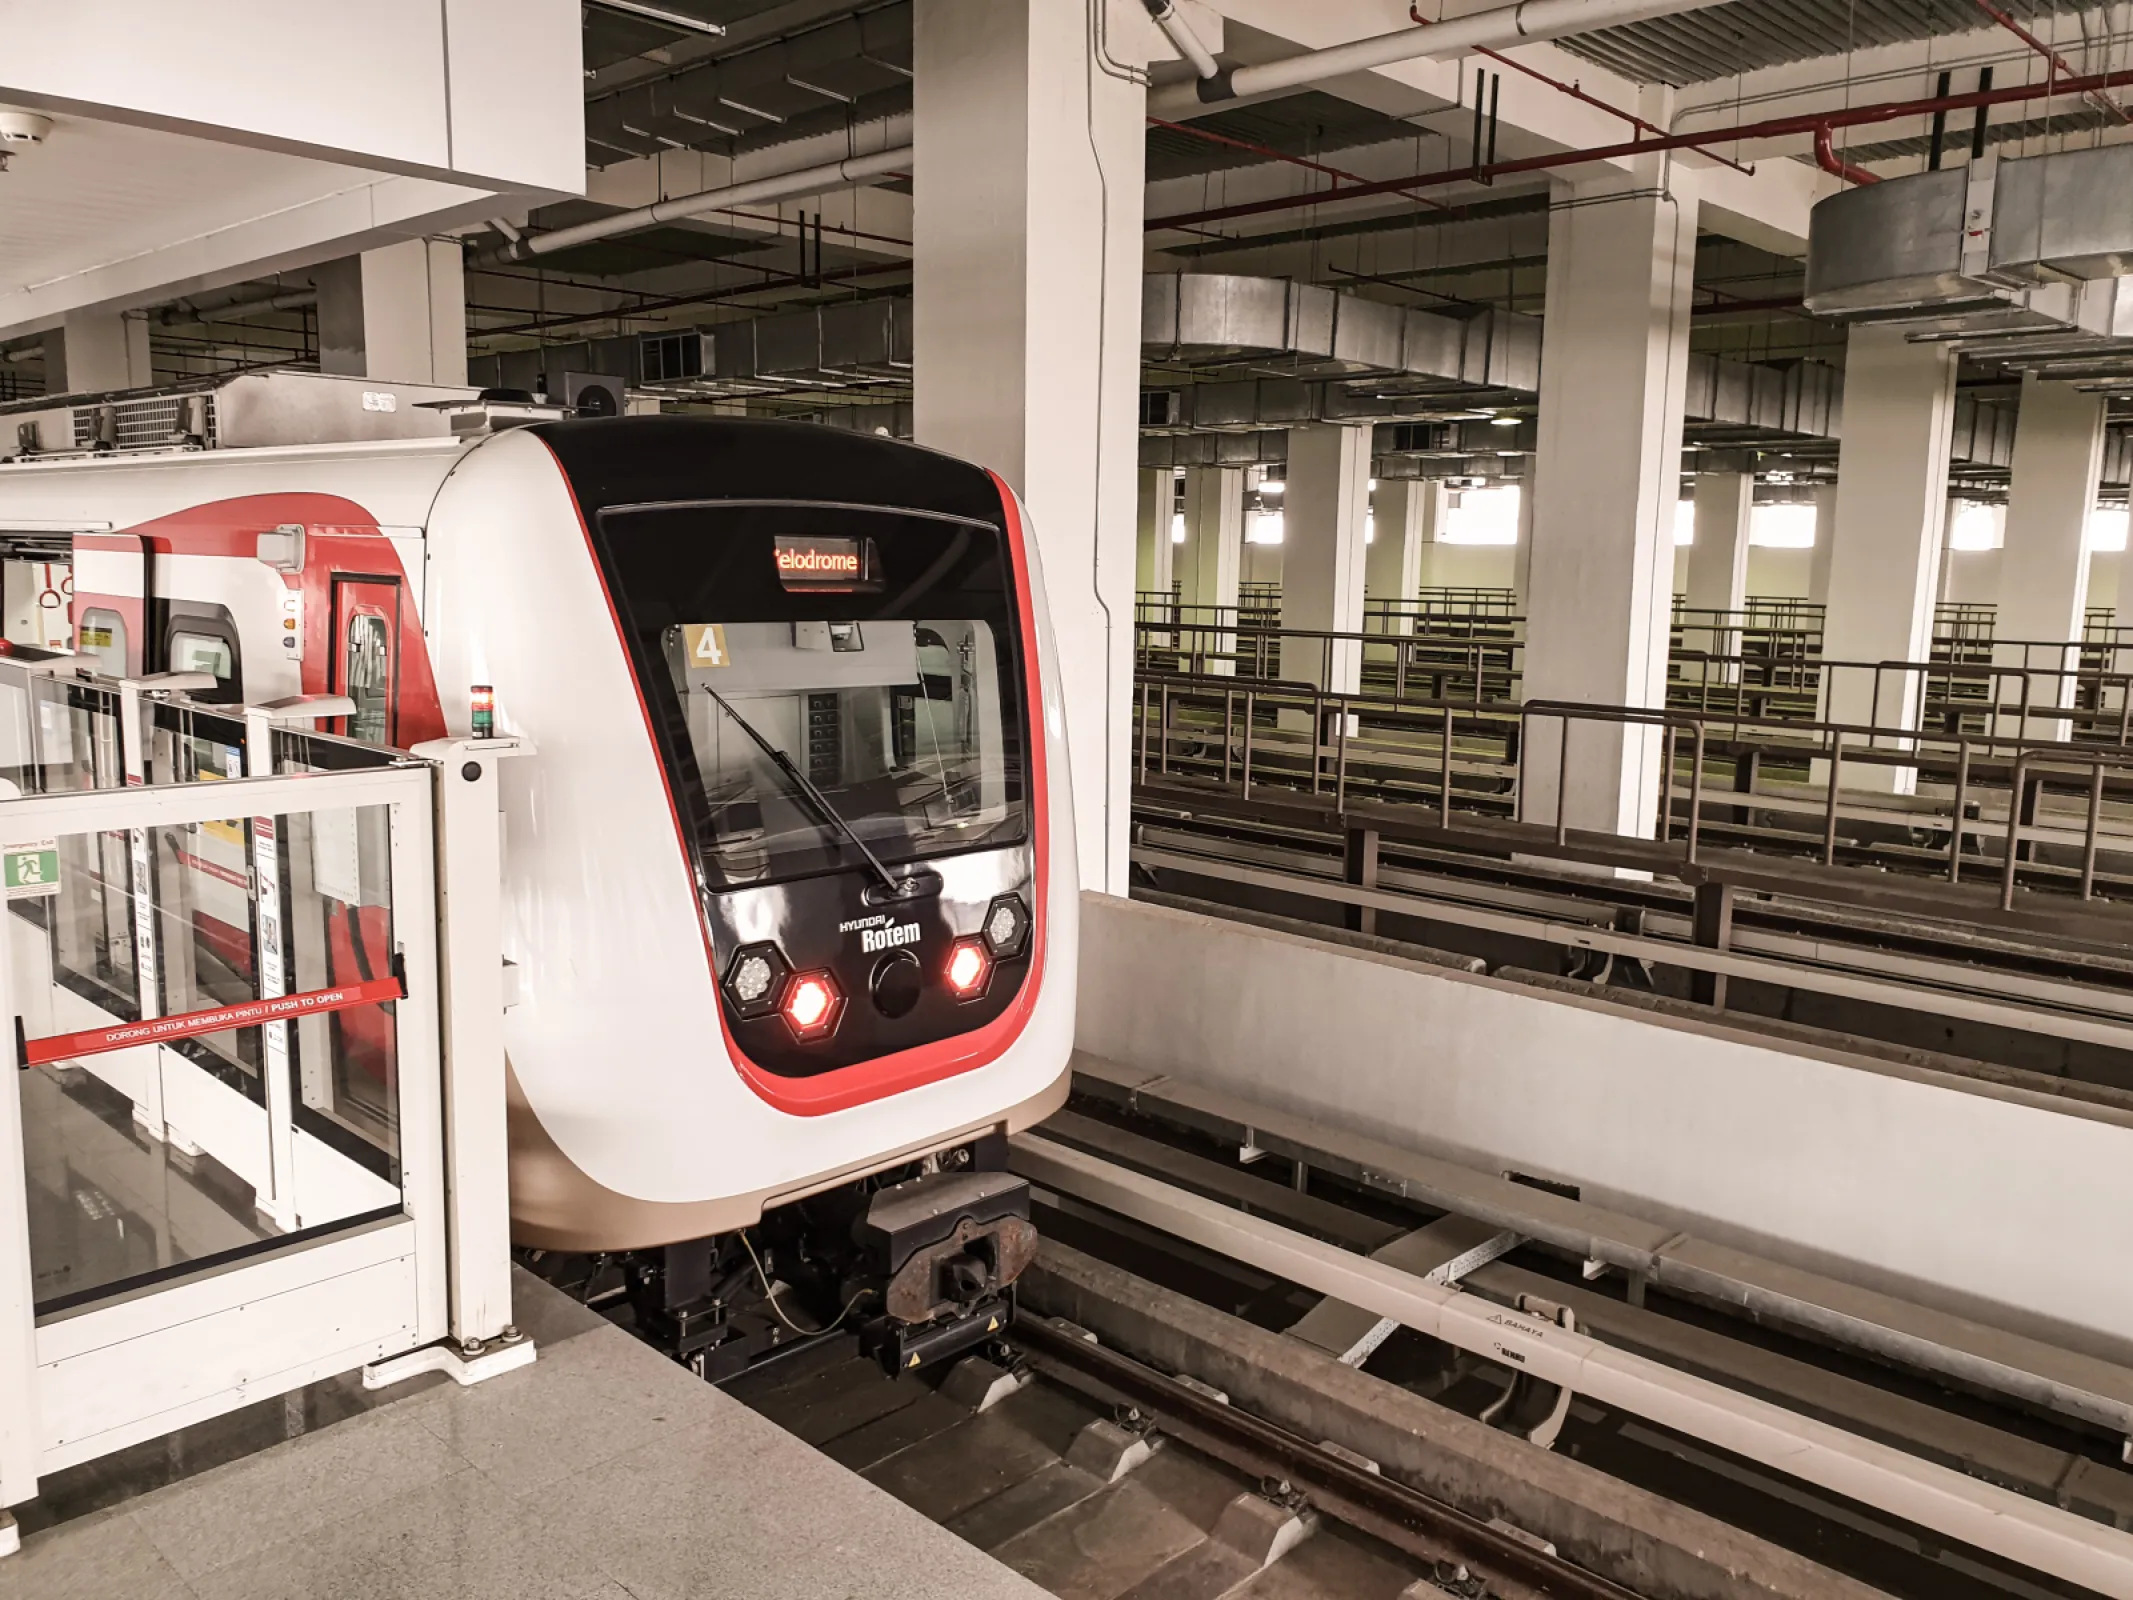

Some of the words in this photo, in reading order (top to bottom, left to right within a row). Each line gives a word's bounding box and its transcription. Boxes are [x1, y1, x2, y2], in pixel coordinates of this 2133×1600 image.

[696, 626, 722, 665] 4
[839, 914, 886, 932] HYUNDAI
[861, 916, 921, 953] Rotem
[106, 1027, 151, 1042] DORONG
[153, 1021, 186, 1034] UNTUK
[187, 1012, 234, 1027] MEMBUKA
[235, 1007, 263, 1019] PINTU
[271, 1000, 299, 1013] PUSH
[301, 997, 315, 1007] TO
[316, 992, 344, 1004] OPEN
[1504, 1319, 1543, 1338] BAHAYA
